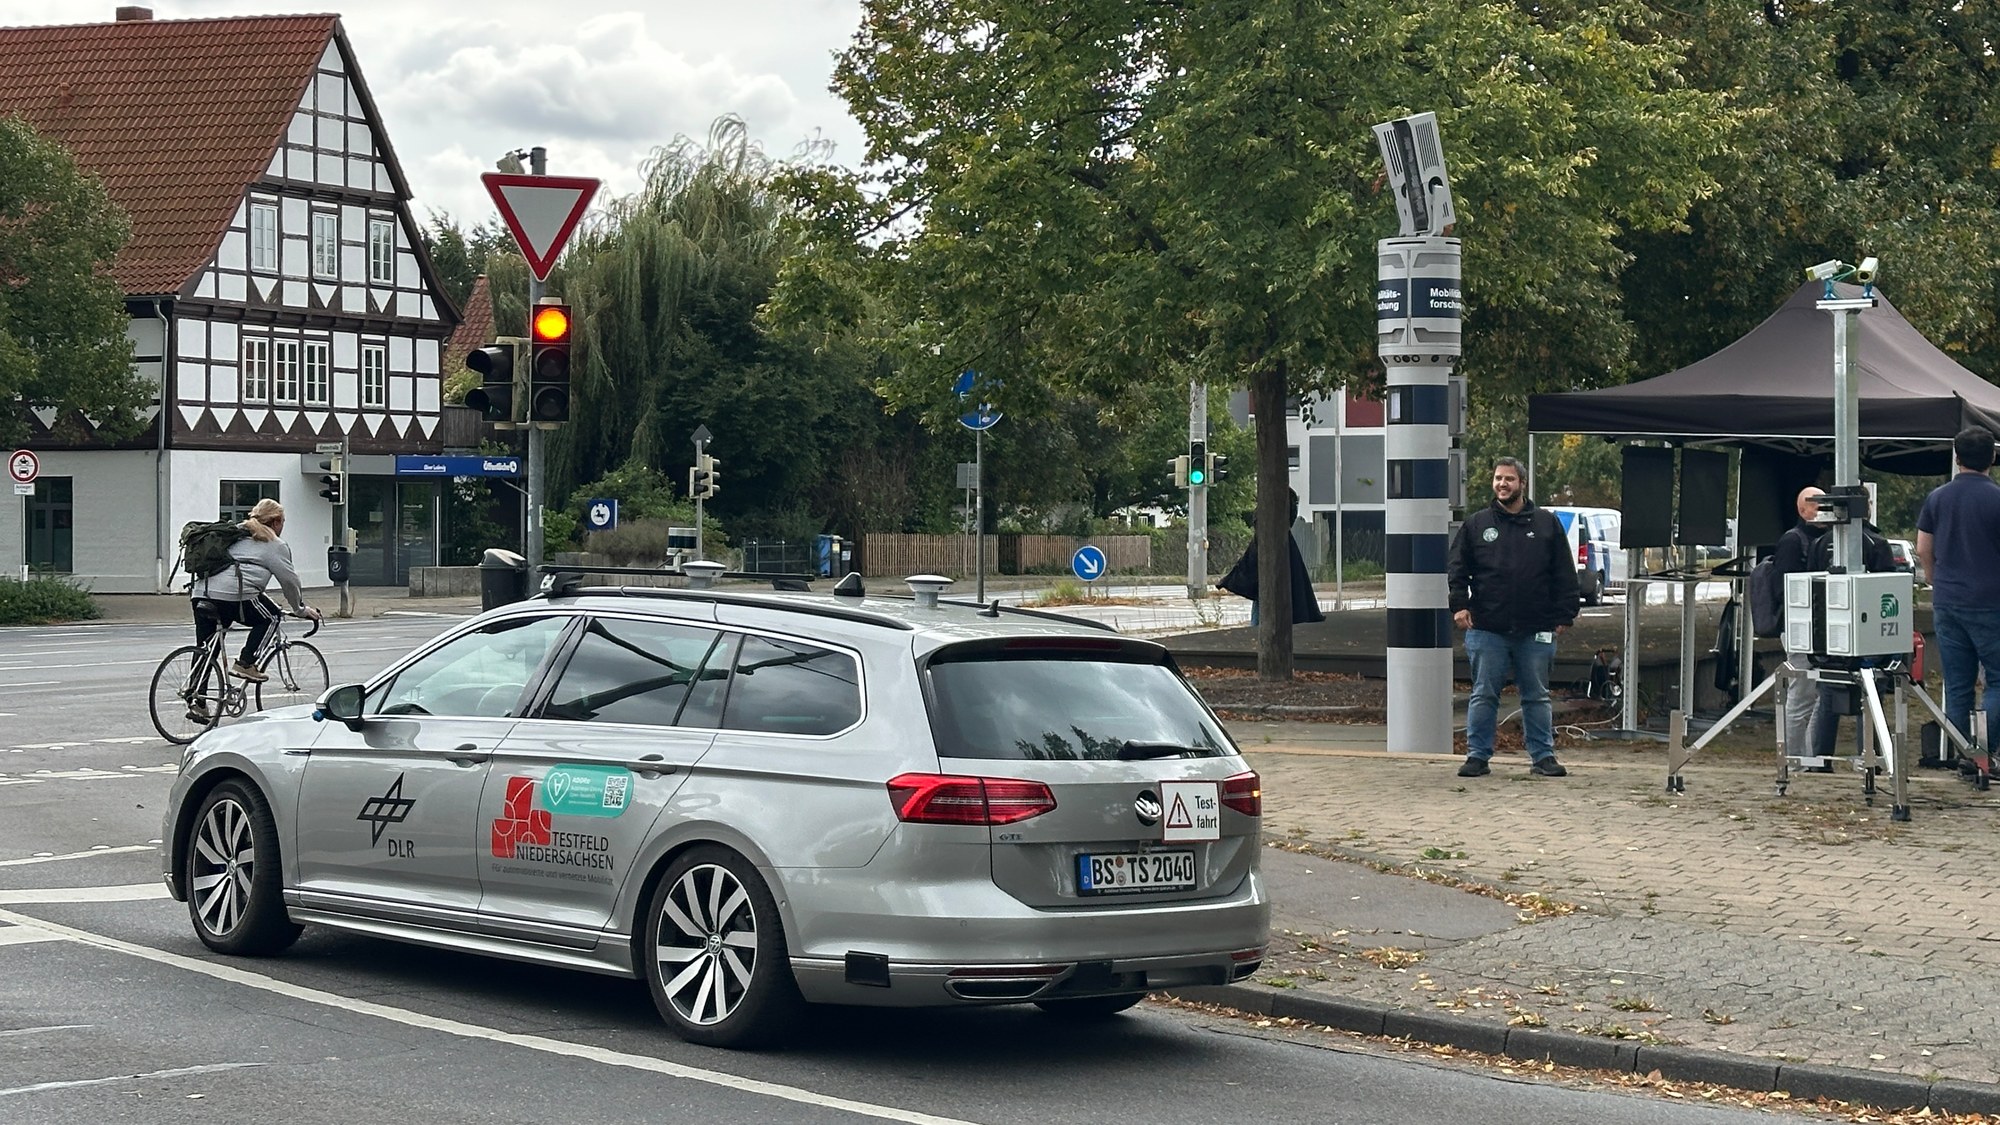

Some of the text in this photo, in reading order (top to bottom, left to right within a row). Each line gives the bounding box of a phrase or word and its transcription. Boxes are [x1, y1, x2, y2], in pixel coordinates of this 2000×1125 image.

[1880, 622, 1899, 637] FZI
[1195, 795, 1217, 810] Test-
[1196, 815, 1218, 830] fahrt
[388, 838, 415, 859] DLR
[552, 831, 609, 852] TESTFELD
[516, 845, 614, 871] NIEDERSACHSEN
[1092, 858, 1115, 885] BS
[1127, 857, 1149, 883] TS
[1153, 855, 1193, 882] 2040
